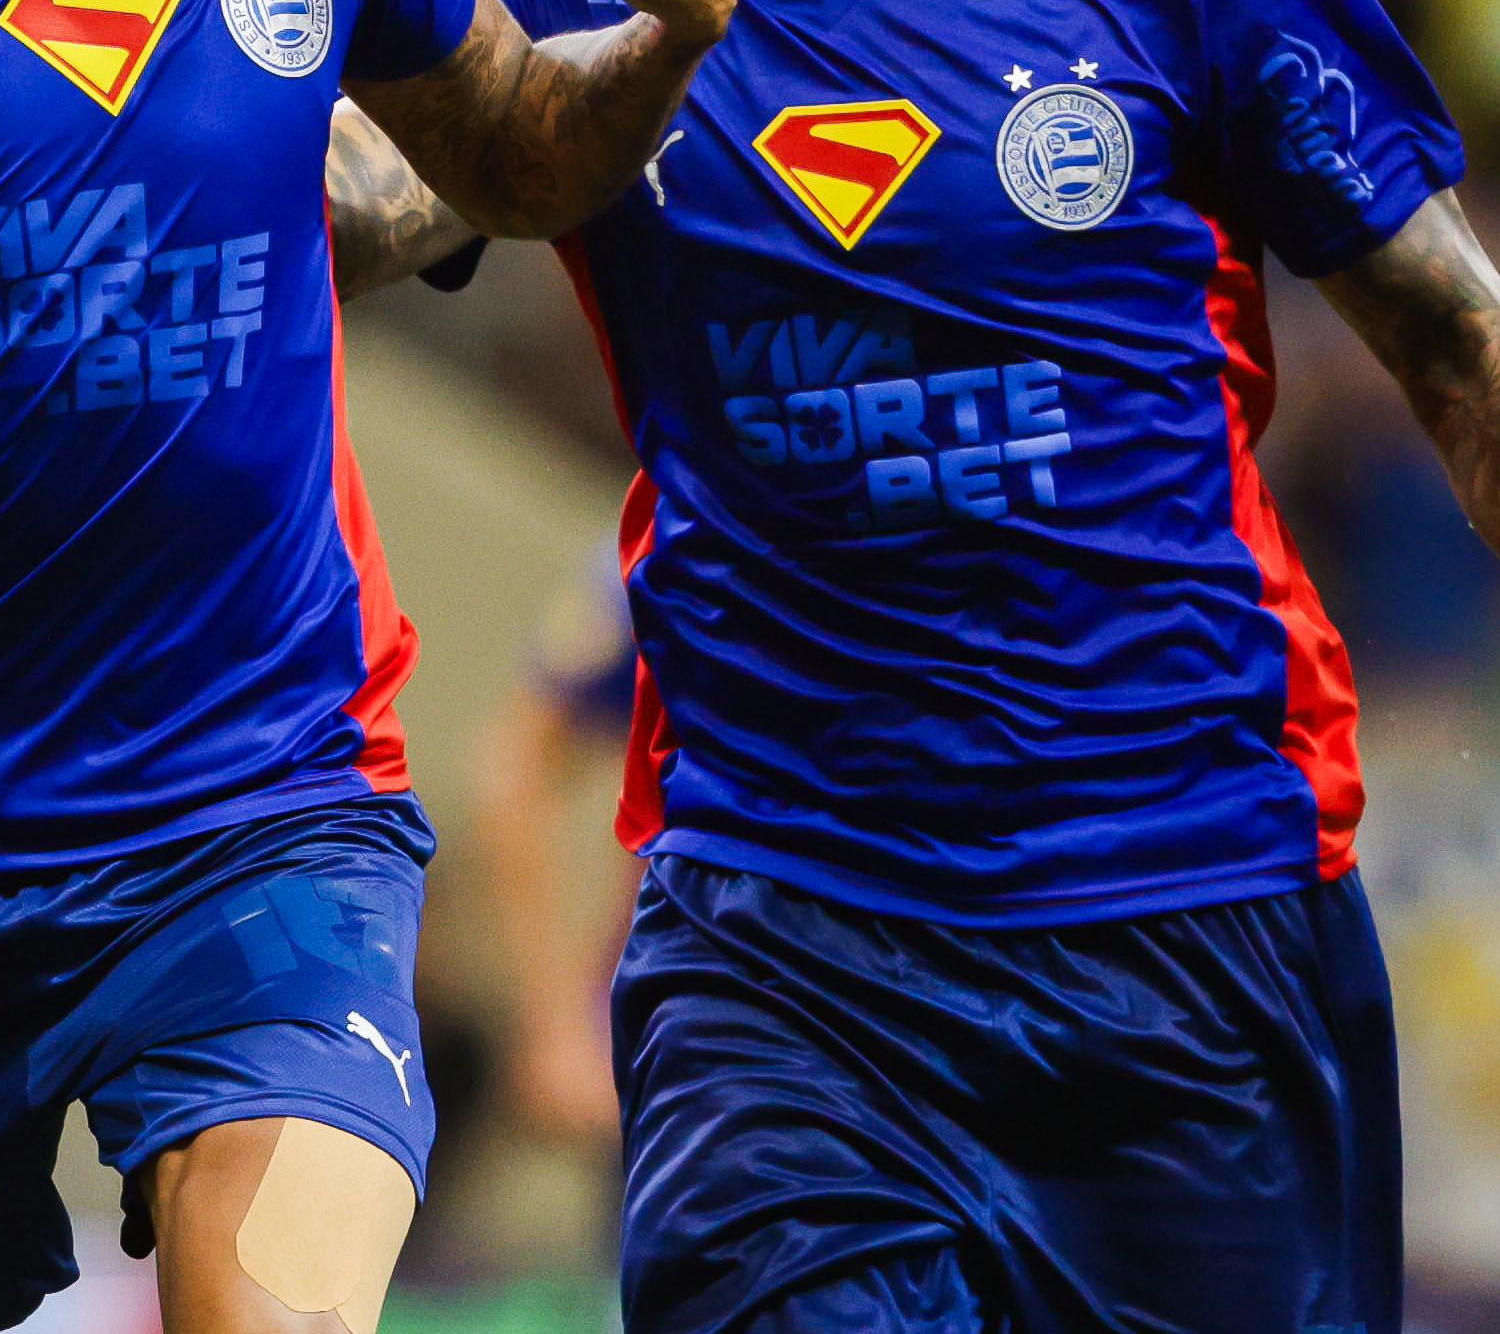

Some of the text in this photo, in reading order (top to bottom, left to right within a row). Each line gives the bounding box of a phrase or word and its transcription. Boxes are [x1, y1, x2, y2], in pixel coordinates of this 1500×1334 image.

[280, 50, 307, 66] 1931
[1008, 109, 1038, 200] ESPORTE
[45, 309, 263, 416] .BET
[706, 312, 916, 391] VIVA
[724, 359, 1067, 466] SORTE
[846, 431, 1073, 532] .BET
